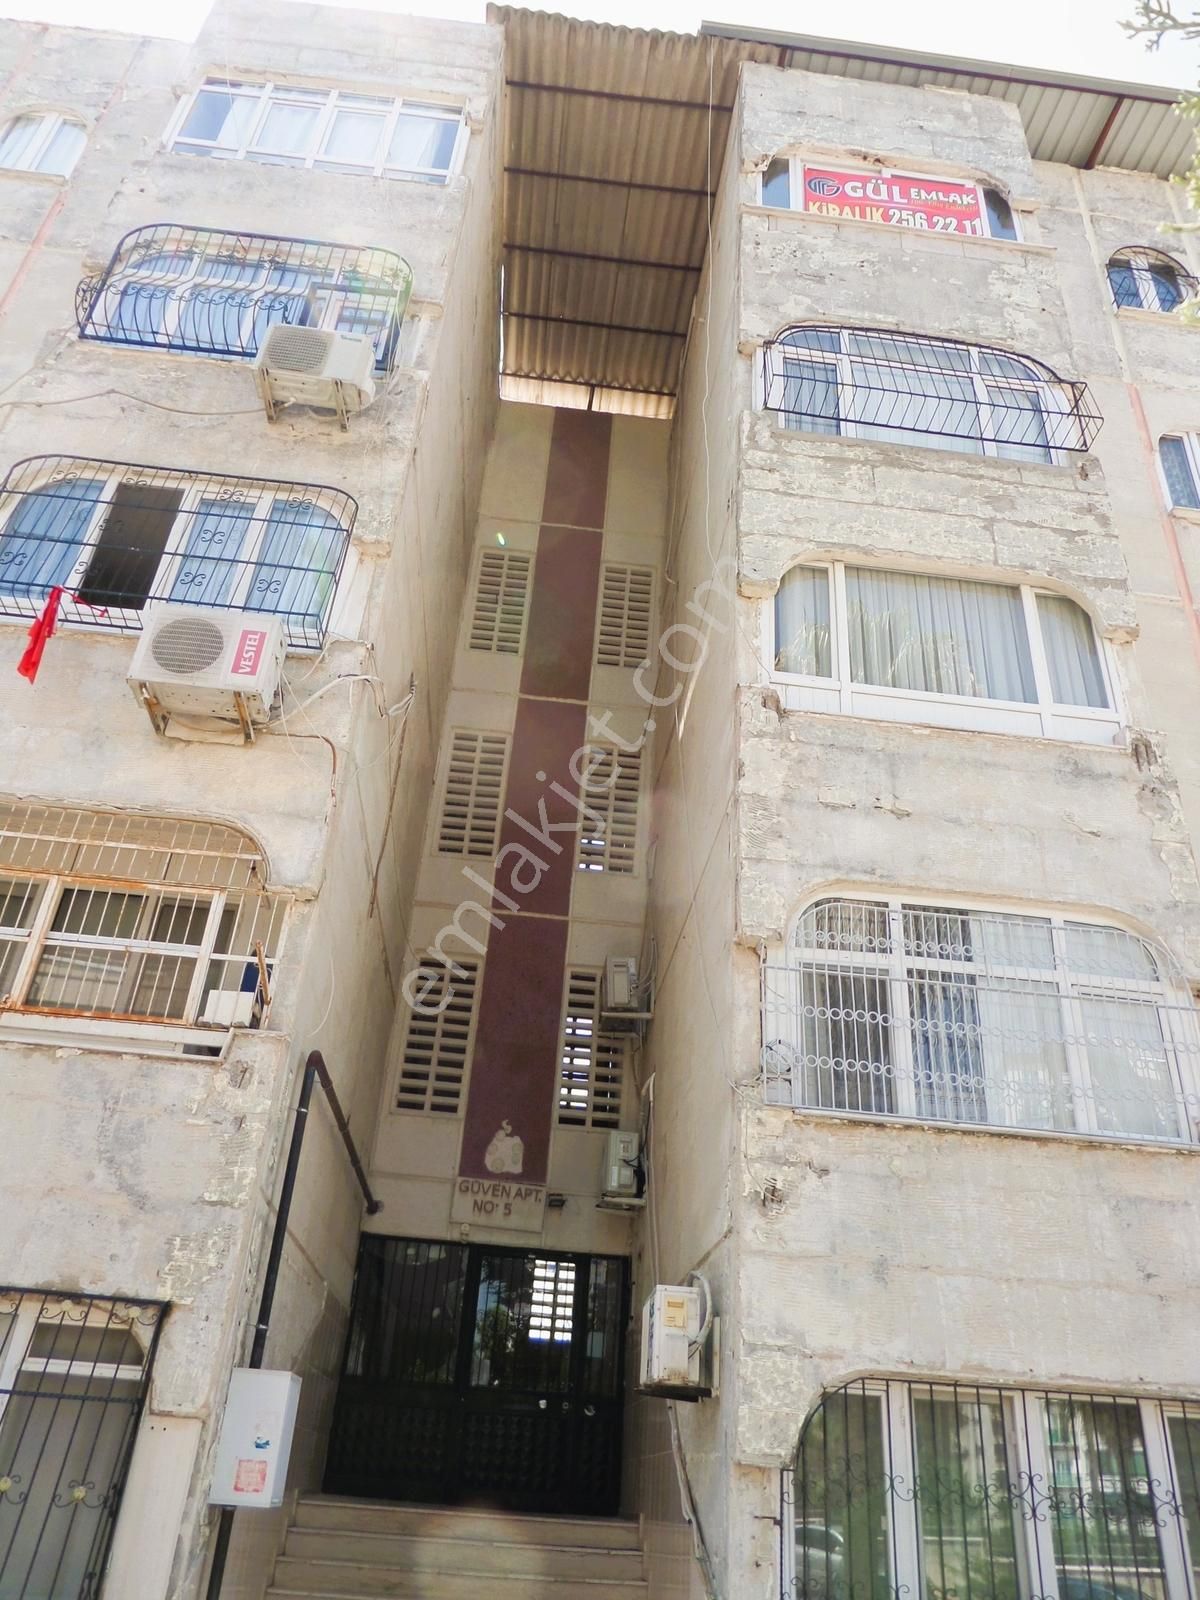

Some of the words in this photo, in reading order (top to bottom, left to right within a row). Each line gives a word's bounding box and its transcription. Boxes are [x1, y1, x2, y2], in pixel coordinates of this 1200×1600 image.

[843, 179, 908, 203] GÜL
[911, 188, 976, 205] EMLAK
[888, 210, 929, 228] 256
[931, 217, 957, 232] 22
[238, 633, 260, 673] VESTEL
[513, 1187, 542, 1203] APT.
[503, 1202, 512, 1217] 5
